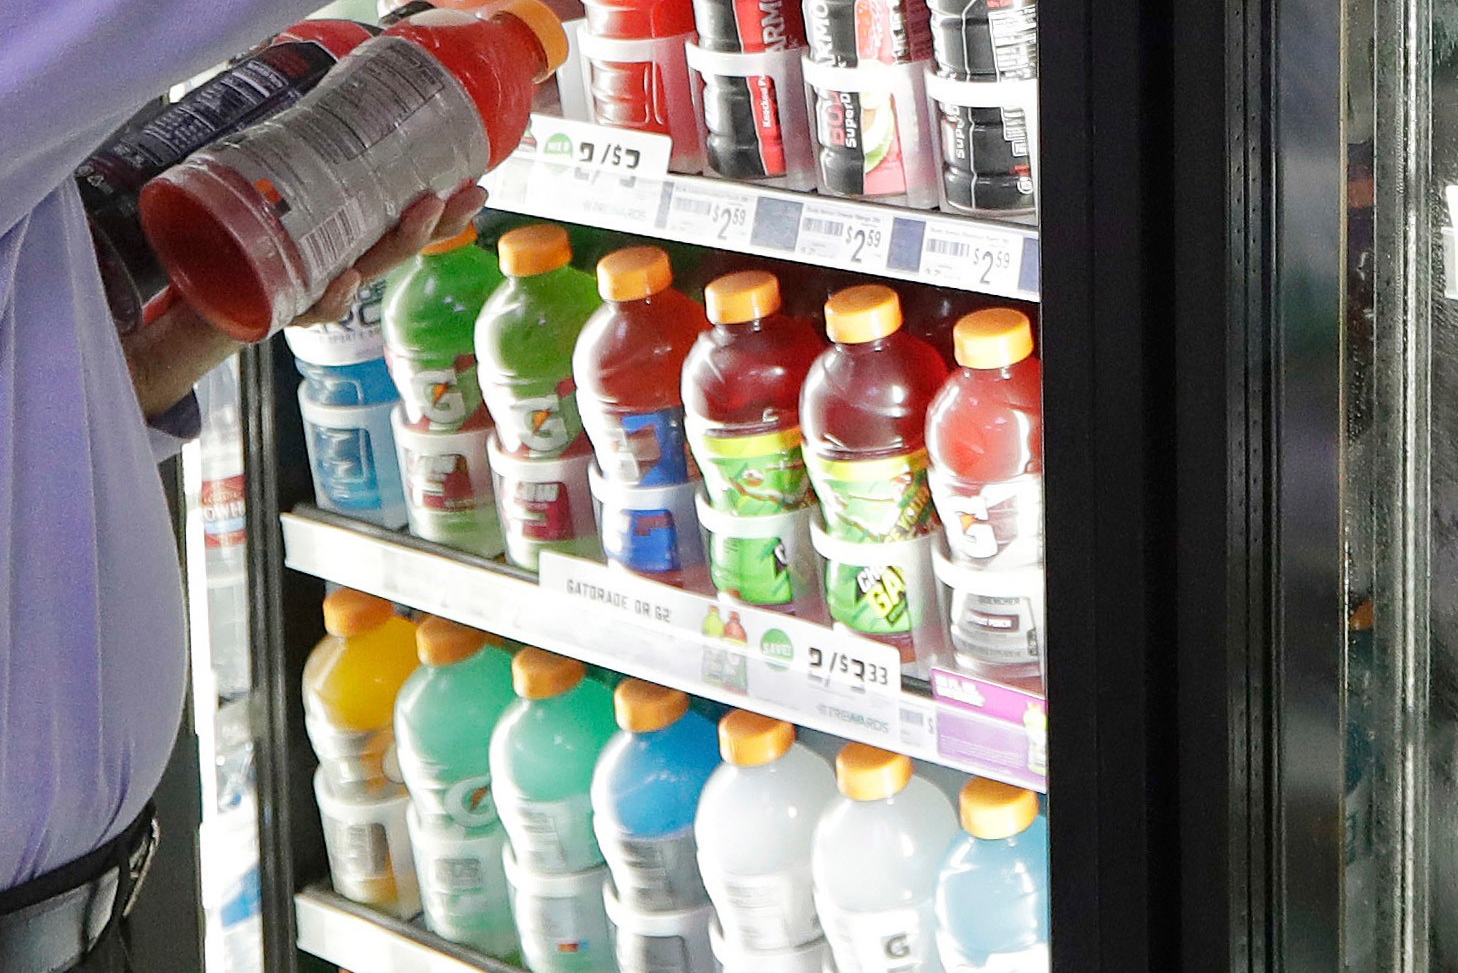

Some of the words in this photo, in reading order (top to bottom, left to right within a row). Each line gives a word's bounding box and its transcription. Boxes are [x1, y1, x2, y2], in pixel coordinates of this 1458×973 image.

[712, 204, 747, 240] $259
[845, 225, 881, 263] $259
[566, 578, 629, 611] GATORADE
[635, 598, 650, 619] OR
